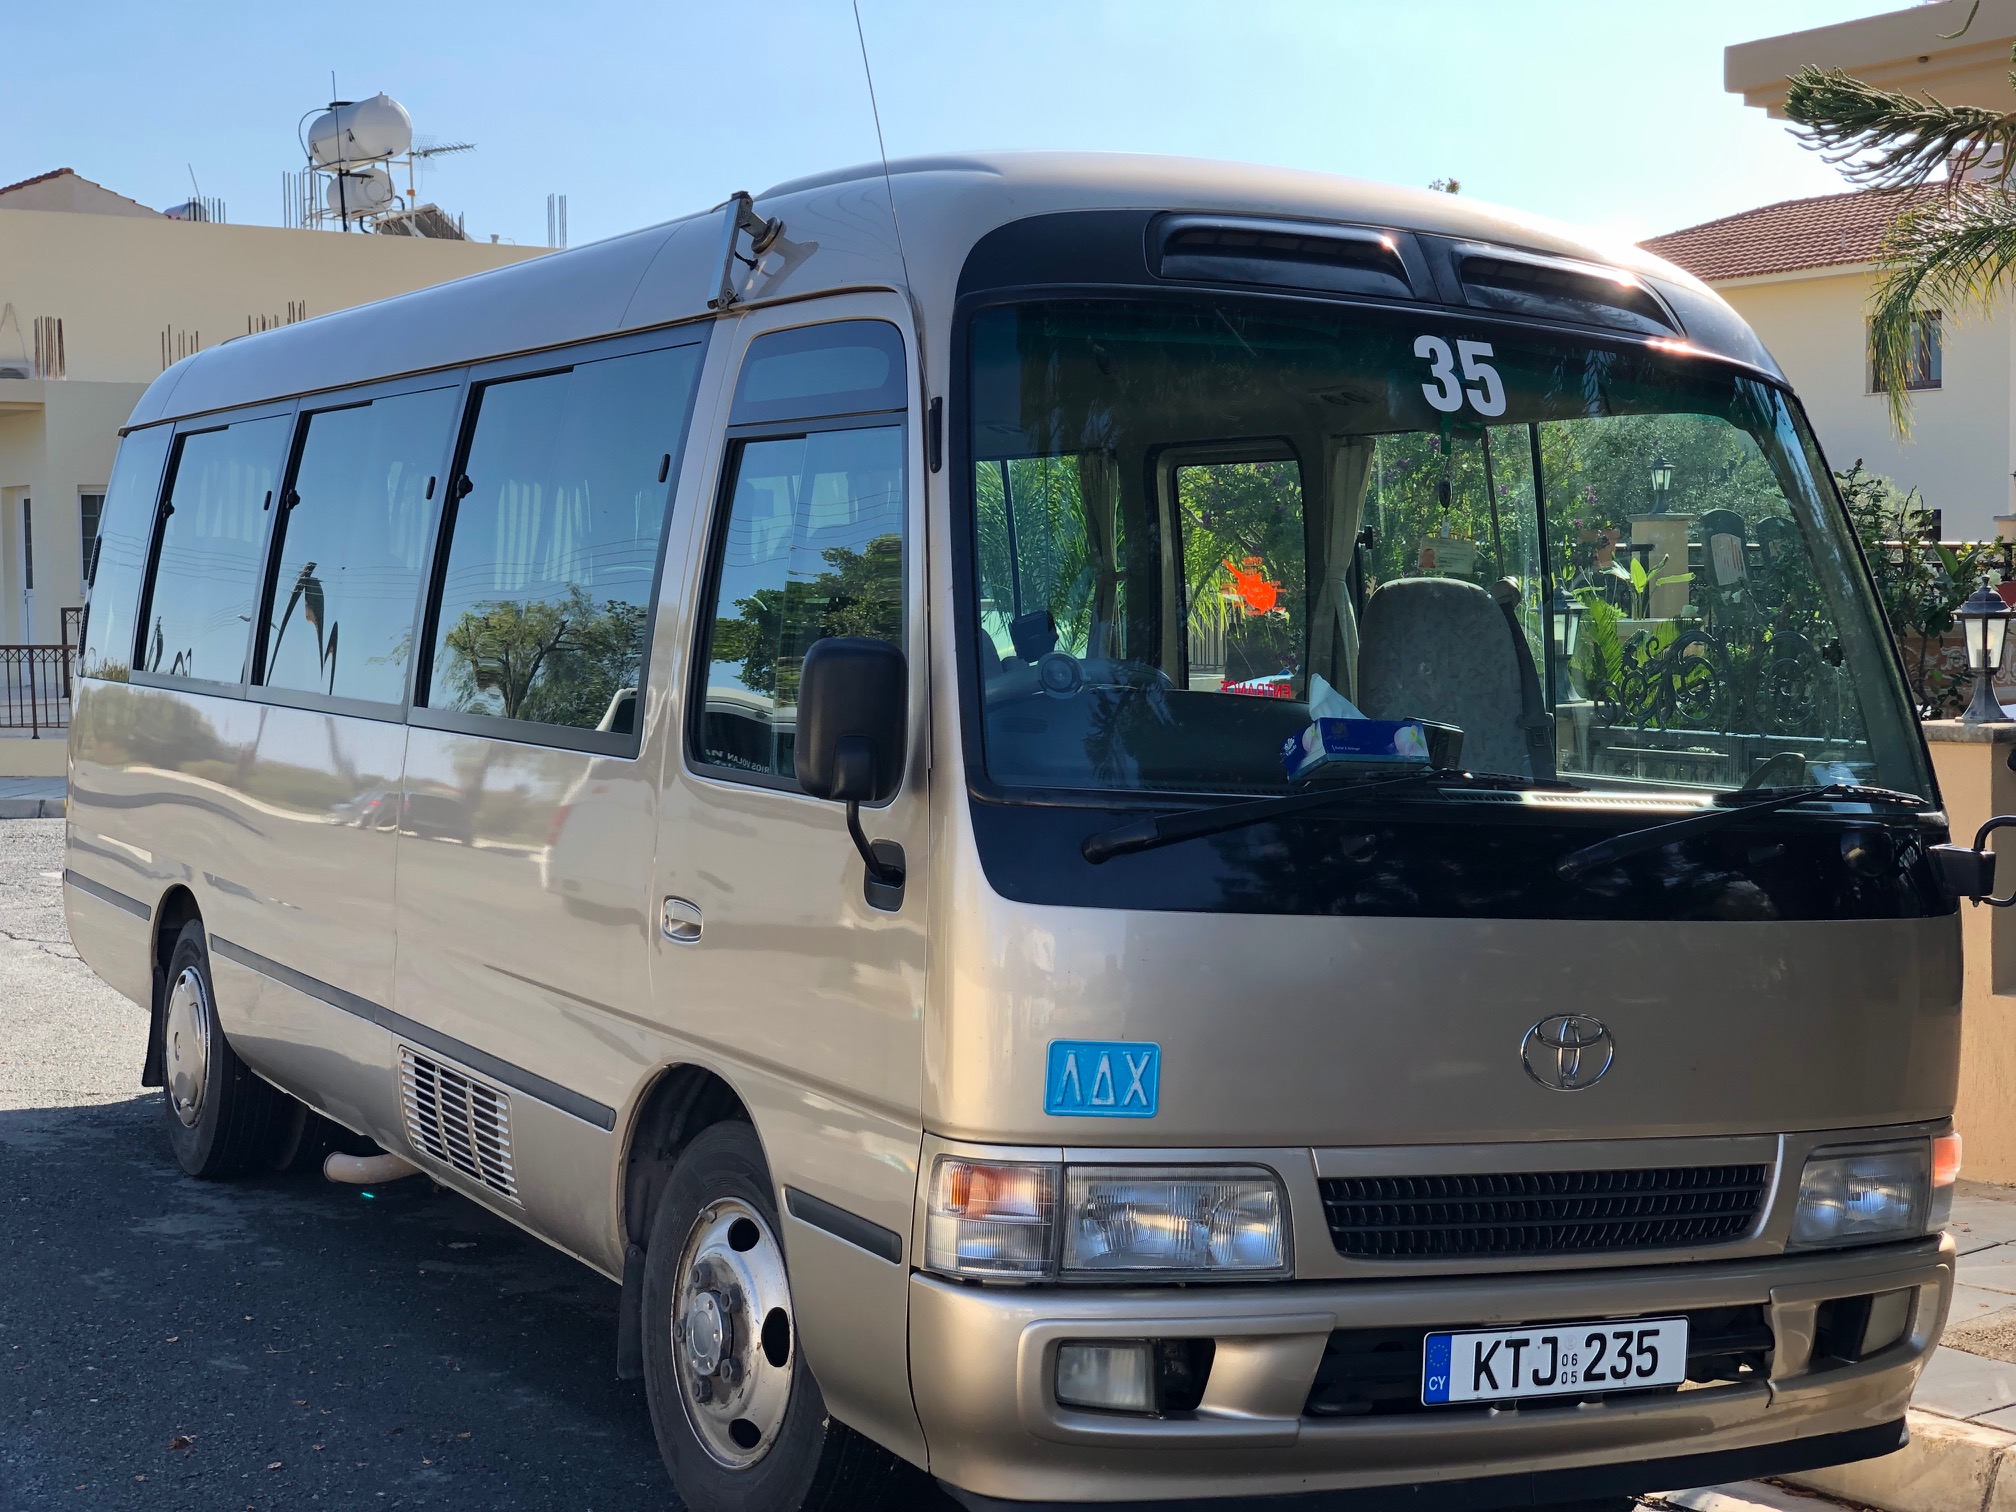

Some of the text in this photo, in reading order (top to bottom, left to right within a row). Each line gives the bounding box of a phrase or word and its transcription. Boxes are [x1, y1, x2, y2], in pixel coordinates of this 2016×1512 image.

[1413, 334, 1507, 417] 35
[1472, 1328, 1660, 1392] KTJ 235
[1561, 1353, 1578, 1367] 06
[1428, 1375, 1447, 1392] CY
[1561, 1370, 1578, 1385] 05
